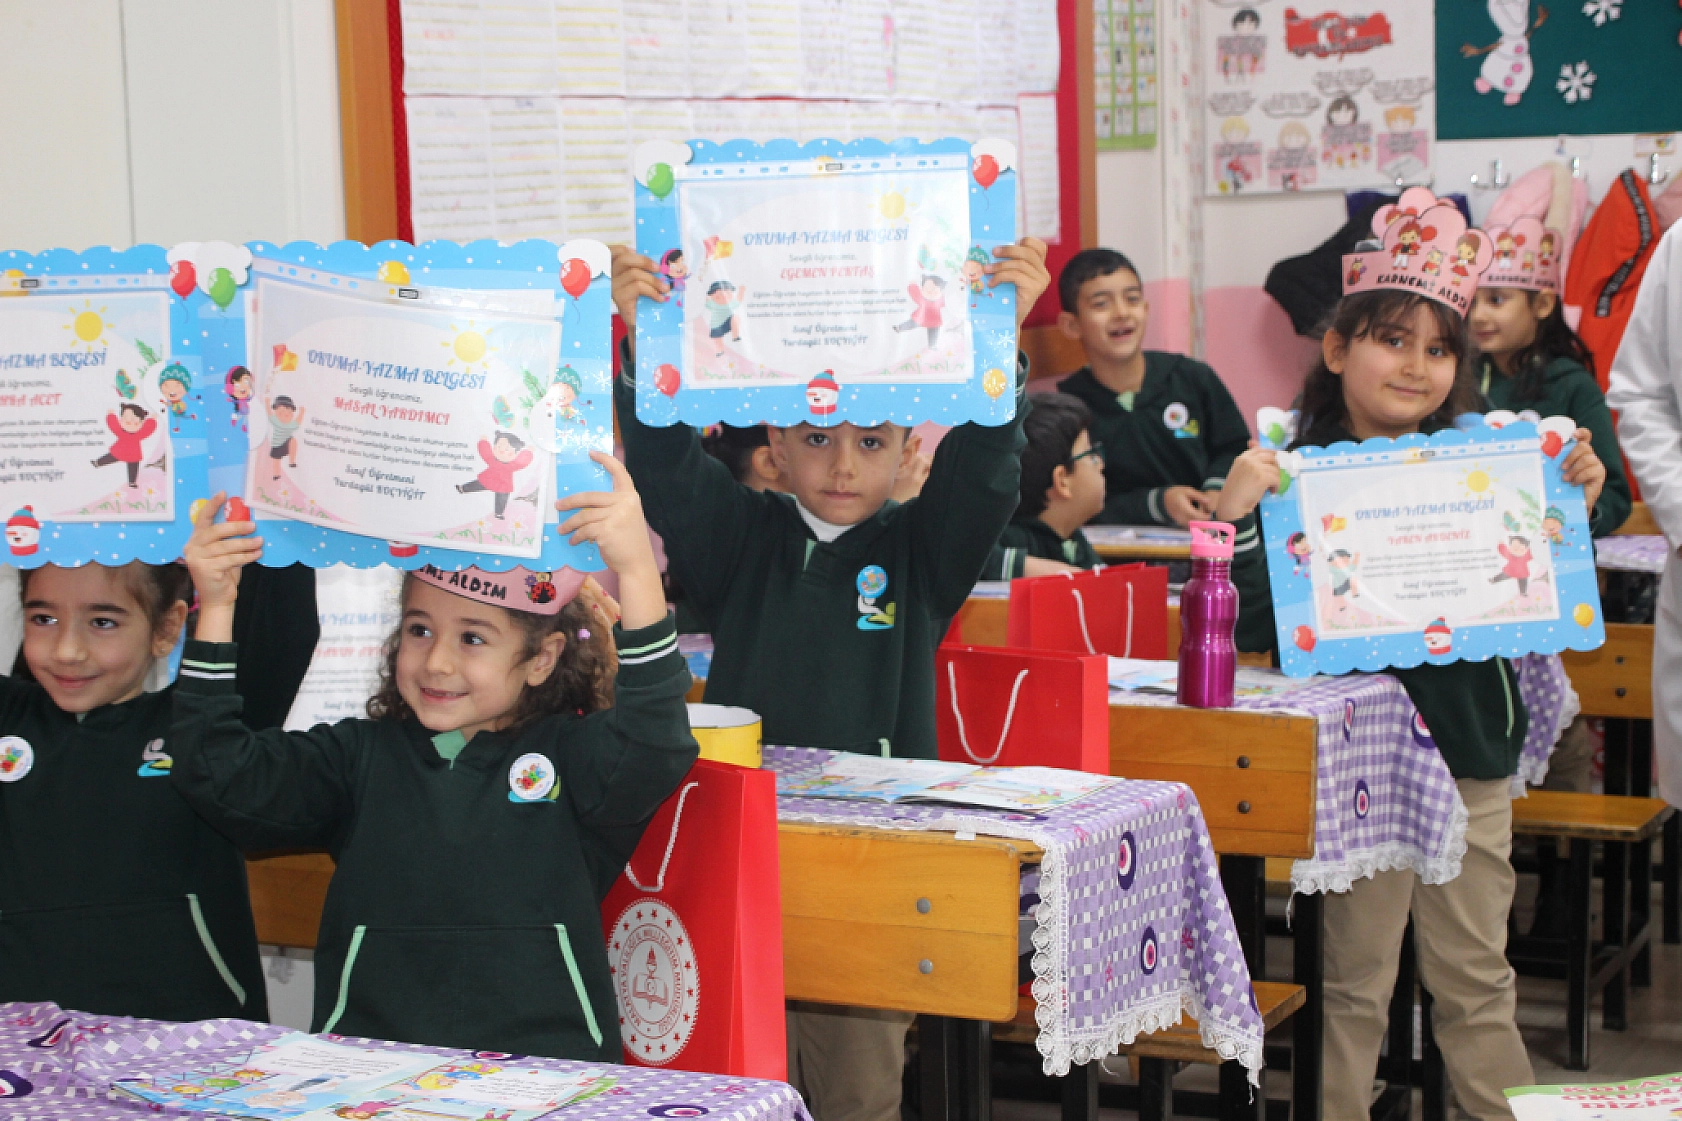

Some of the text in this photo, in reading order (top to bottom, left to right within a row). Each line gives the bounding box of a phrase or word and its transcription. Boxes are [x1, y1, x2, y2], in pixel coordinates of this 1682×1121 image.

[307, 349, 487, 391] OKUMA-YAZMA BELGESİ
[333, 396, 379, 420] MASAL
[449, 572, 507, 600] ALDIM
